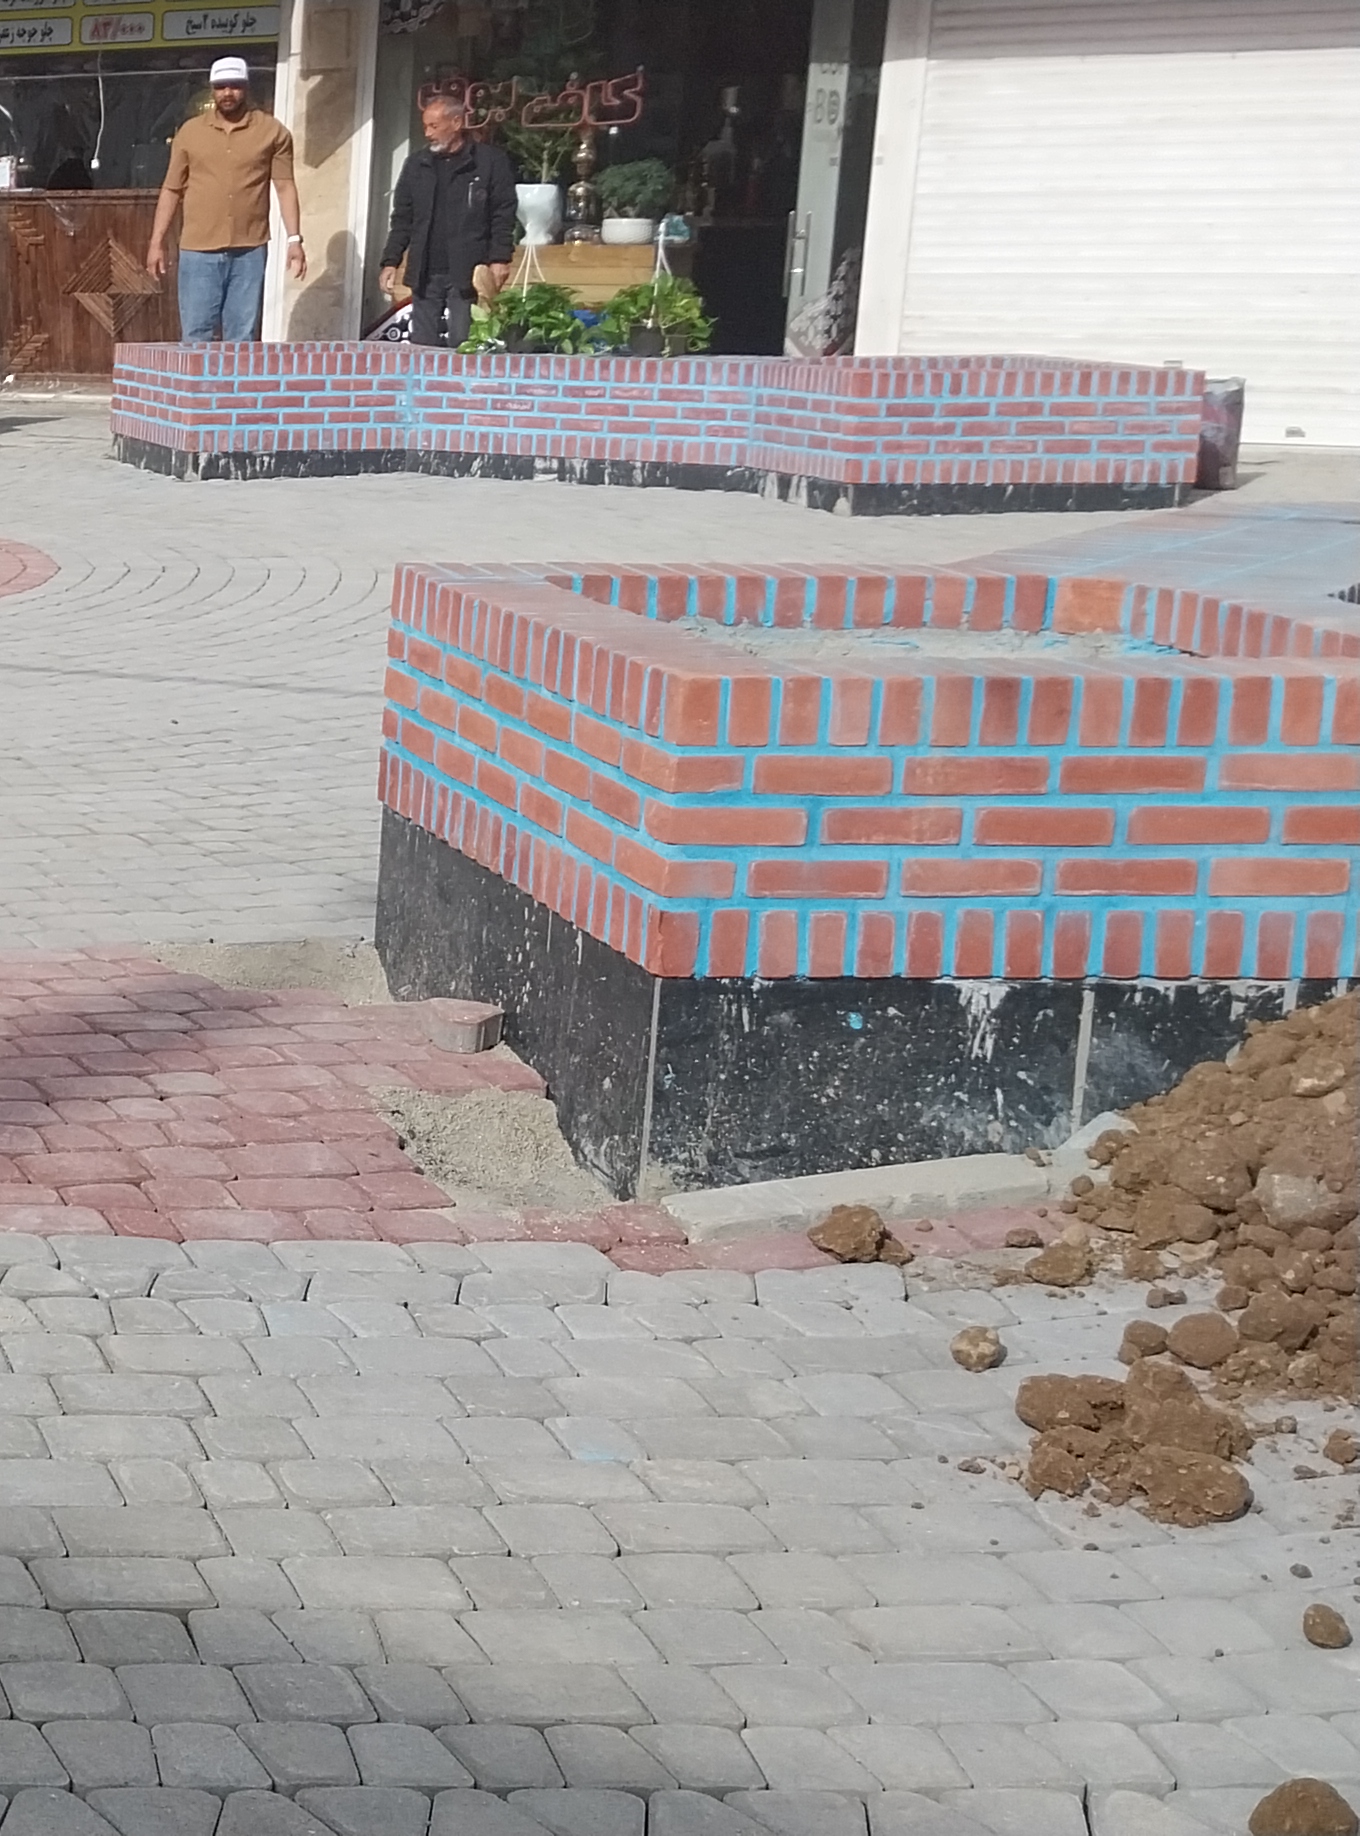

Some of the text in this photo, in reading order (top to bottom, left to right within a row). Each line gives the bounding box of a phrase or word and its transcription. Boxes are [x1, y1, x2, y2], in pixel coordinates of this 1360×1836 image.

[40, 21, 54, 43] چلو
[211, 11, 240, 34] کوبیده
[241, 12, 257, 34] چلو
[17, 28, 38, 43] جوجه
